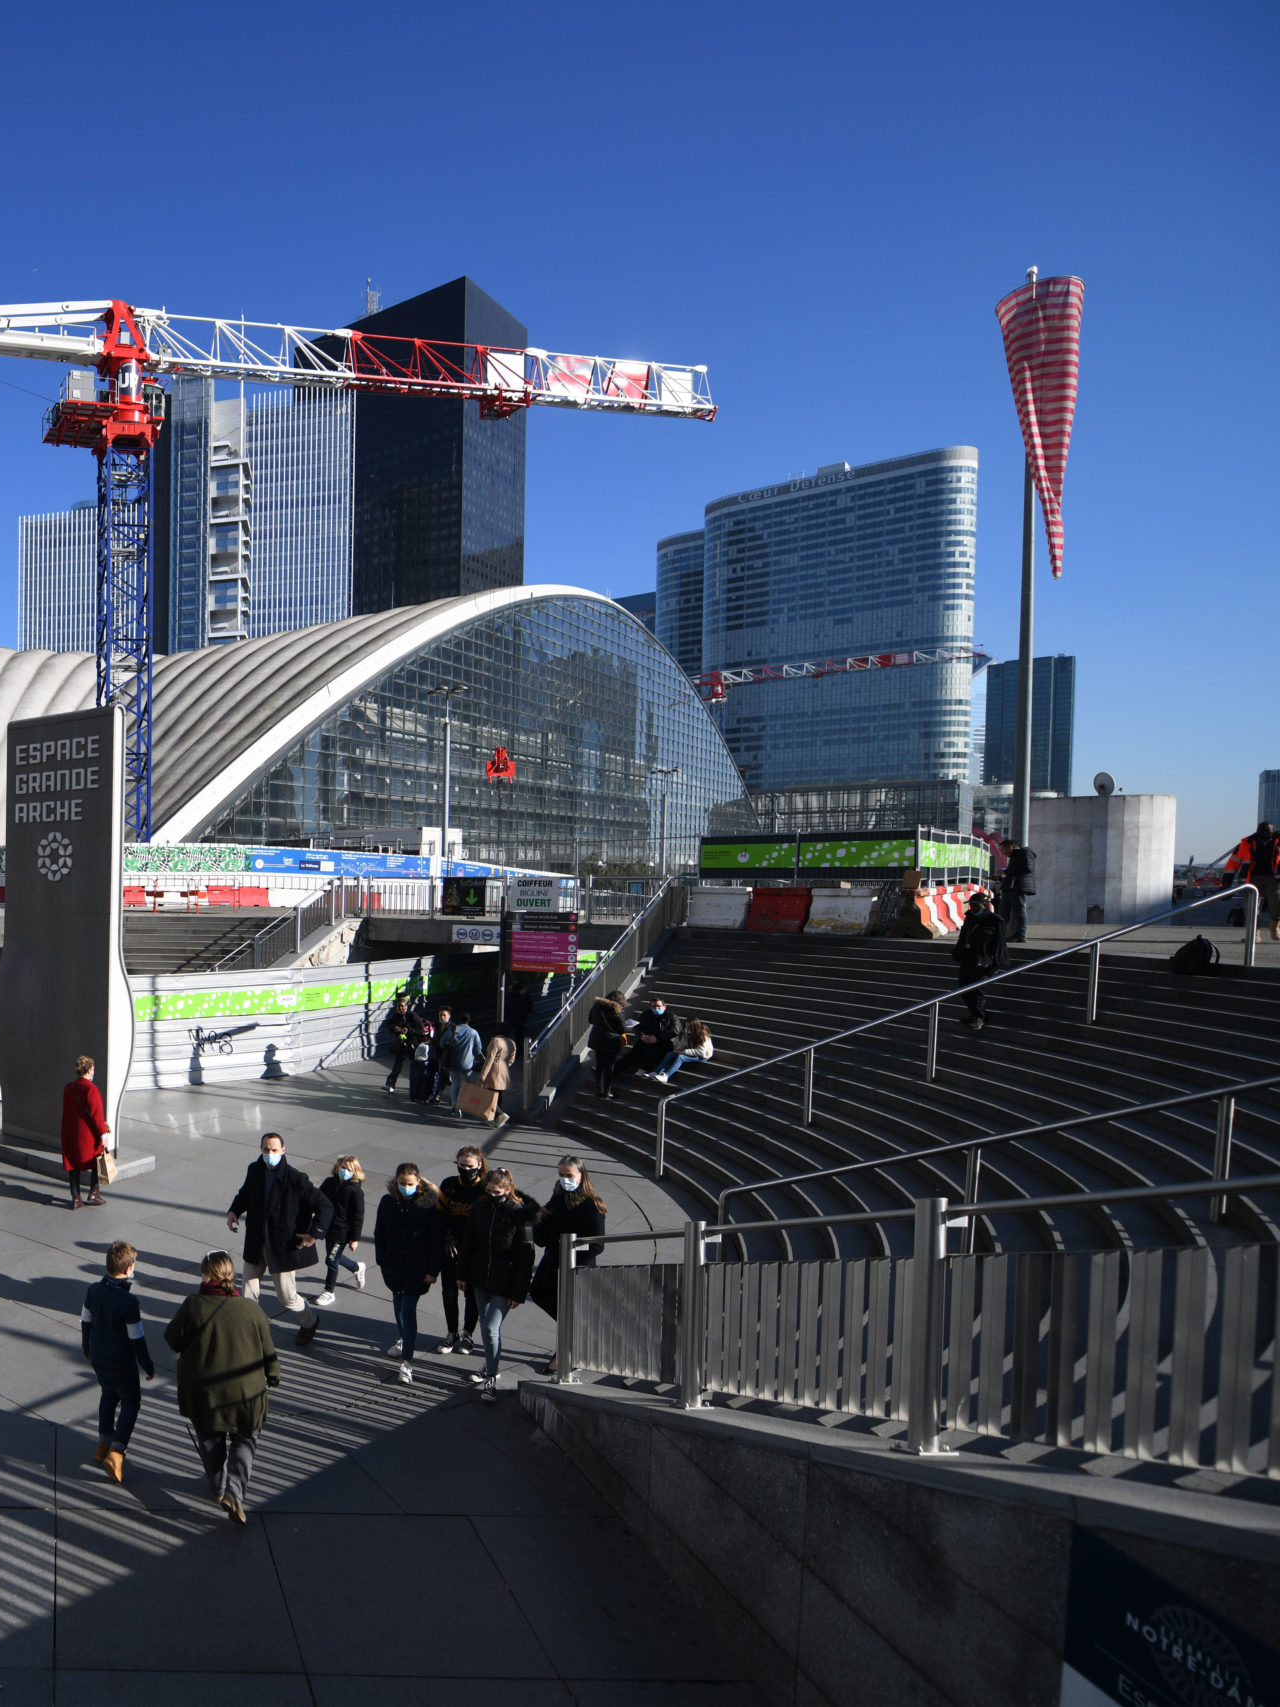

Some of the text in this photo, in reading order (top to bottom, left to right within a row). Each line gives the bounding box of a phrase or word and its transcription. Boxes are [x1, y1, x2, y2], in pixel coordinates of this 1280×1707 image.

[15, 735, 100, 766] ESPACE
[15, 766, 100, 795] GRANDE
[14, 799, 83, 824] ARCHE
[517, 879, 553, 888] COIFFEUR
[516, 898, 552, 908] OUVERT
